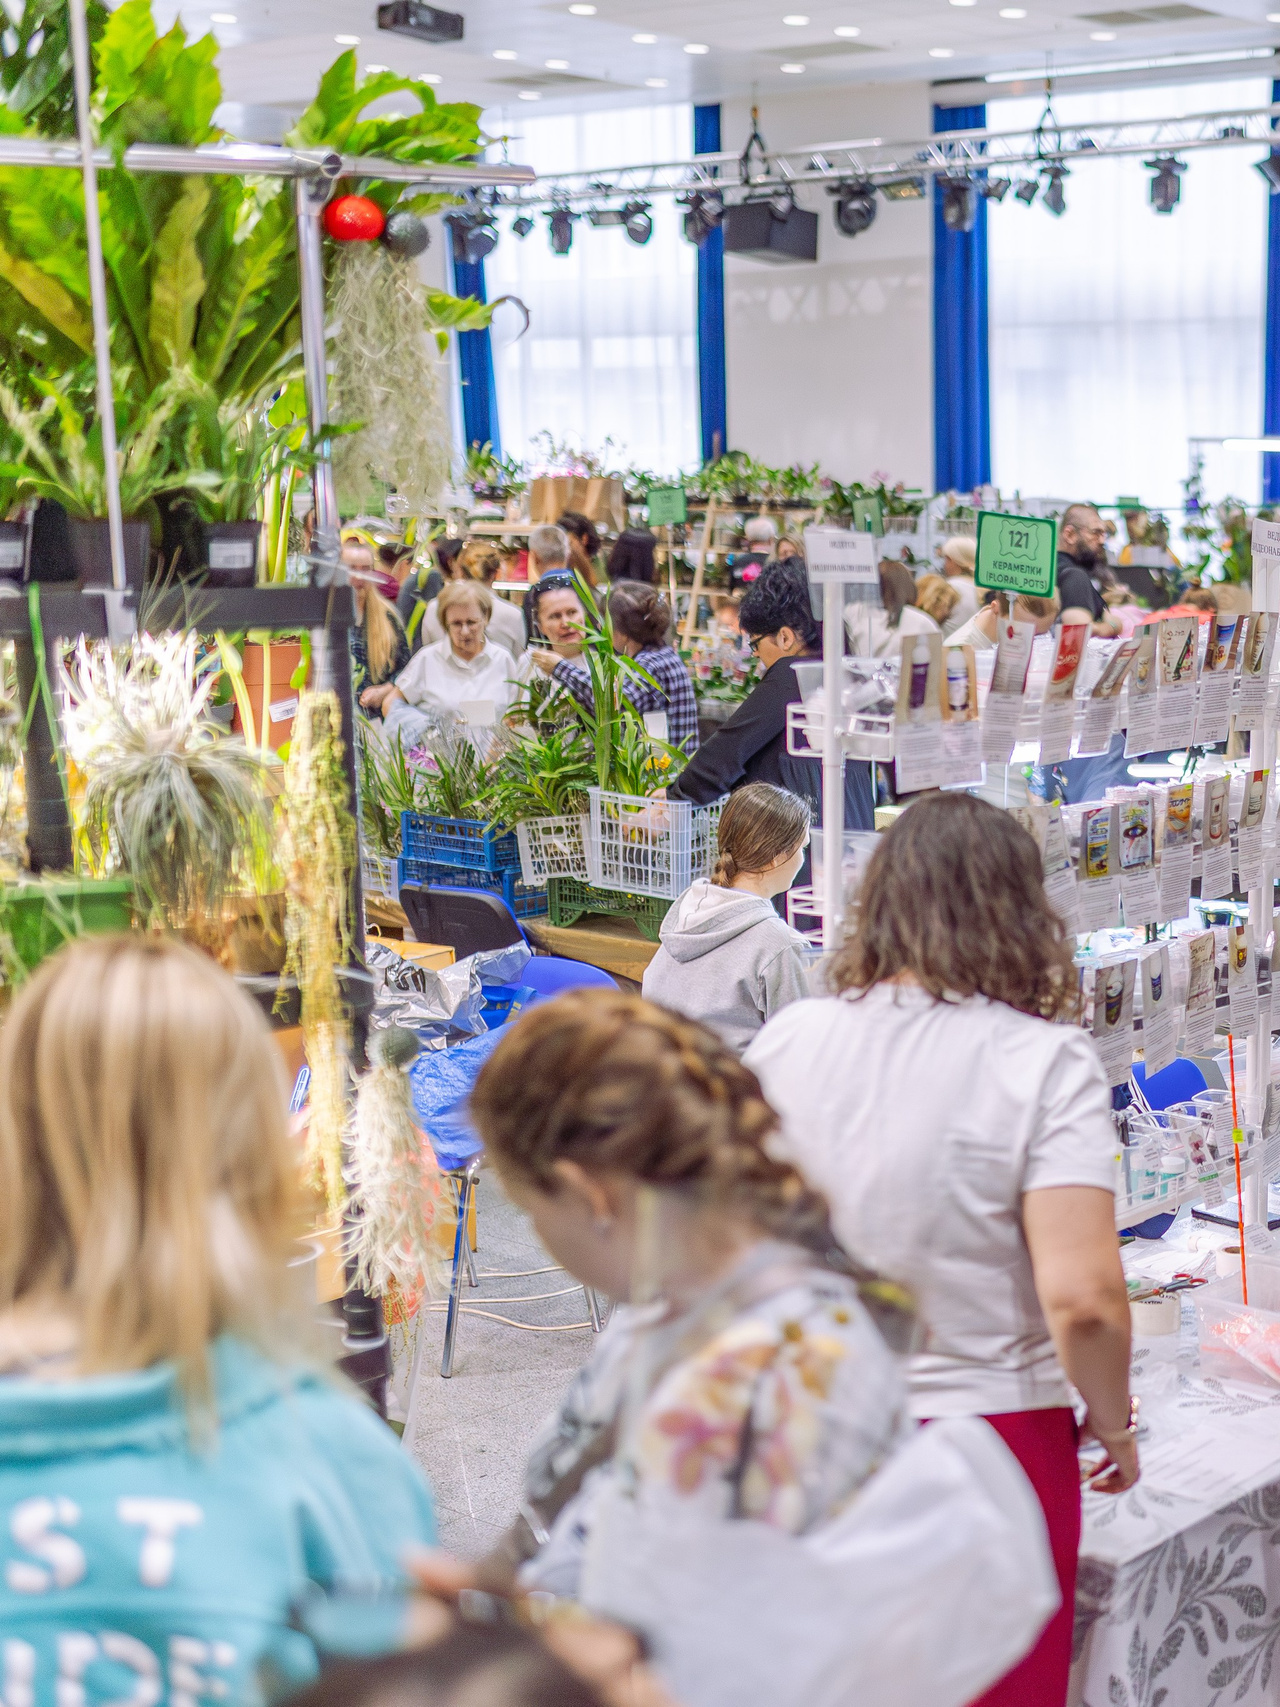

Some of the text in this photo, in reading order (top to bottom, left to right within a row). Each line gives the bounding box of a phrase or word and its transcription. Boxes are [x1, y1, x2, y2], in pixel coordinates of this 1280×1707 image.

[1009, 530, 1029, 549] 121
[992, 560, 1042, 576] КЕРАМЕЛКИ
[986, 571, 1048, 590] (FLORAL_POTS)
